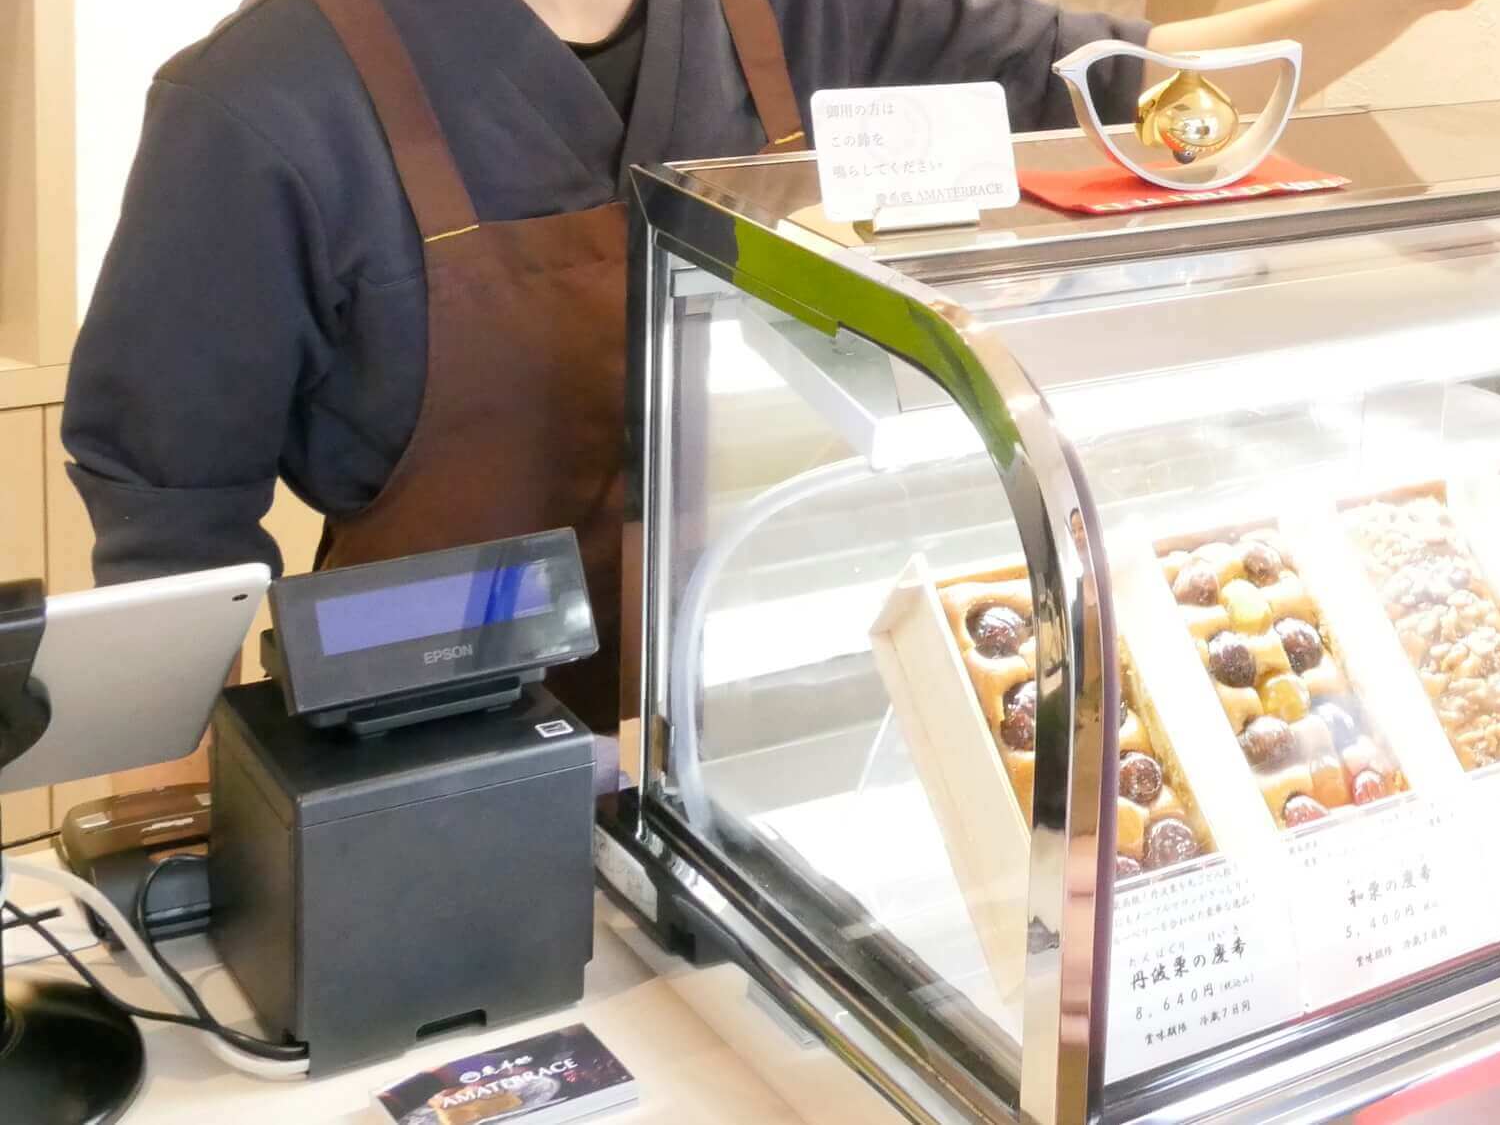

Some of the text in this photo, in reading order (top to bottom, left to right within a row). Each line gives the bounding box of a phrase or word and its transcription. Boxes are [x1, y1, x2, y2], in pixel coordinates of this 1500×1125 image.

[826, 101, 895, 119] 御用の方は
[831, 132, 885, 148] この鈴を
[916, 183, 1004, 203] AMATERRACE
[424, 644, 473, 665] EPSON
[1130, 936, 1248, 991] 丹波栗の慶希
[1144, 1024, 1188, 1046] 賞味期限
[443, 1058, 578, 1108] AMATERRACE
